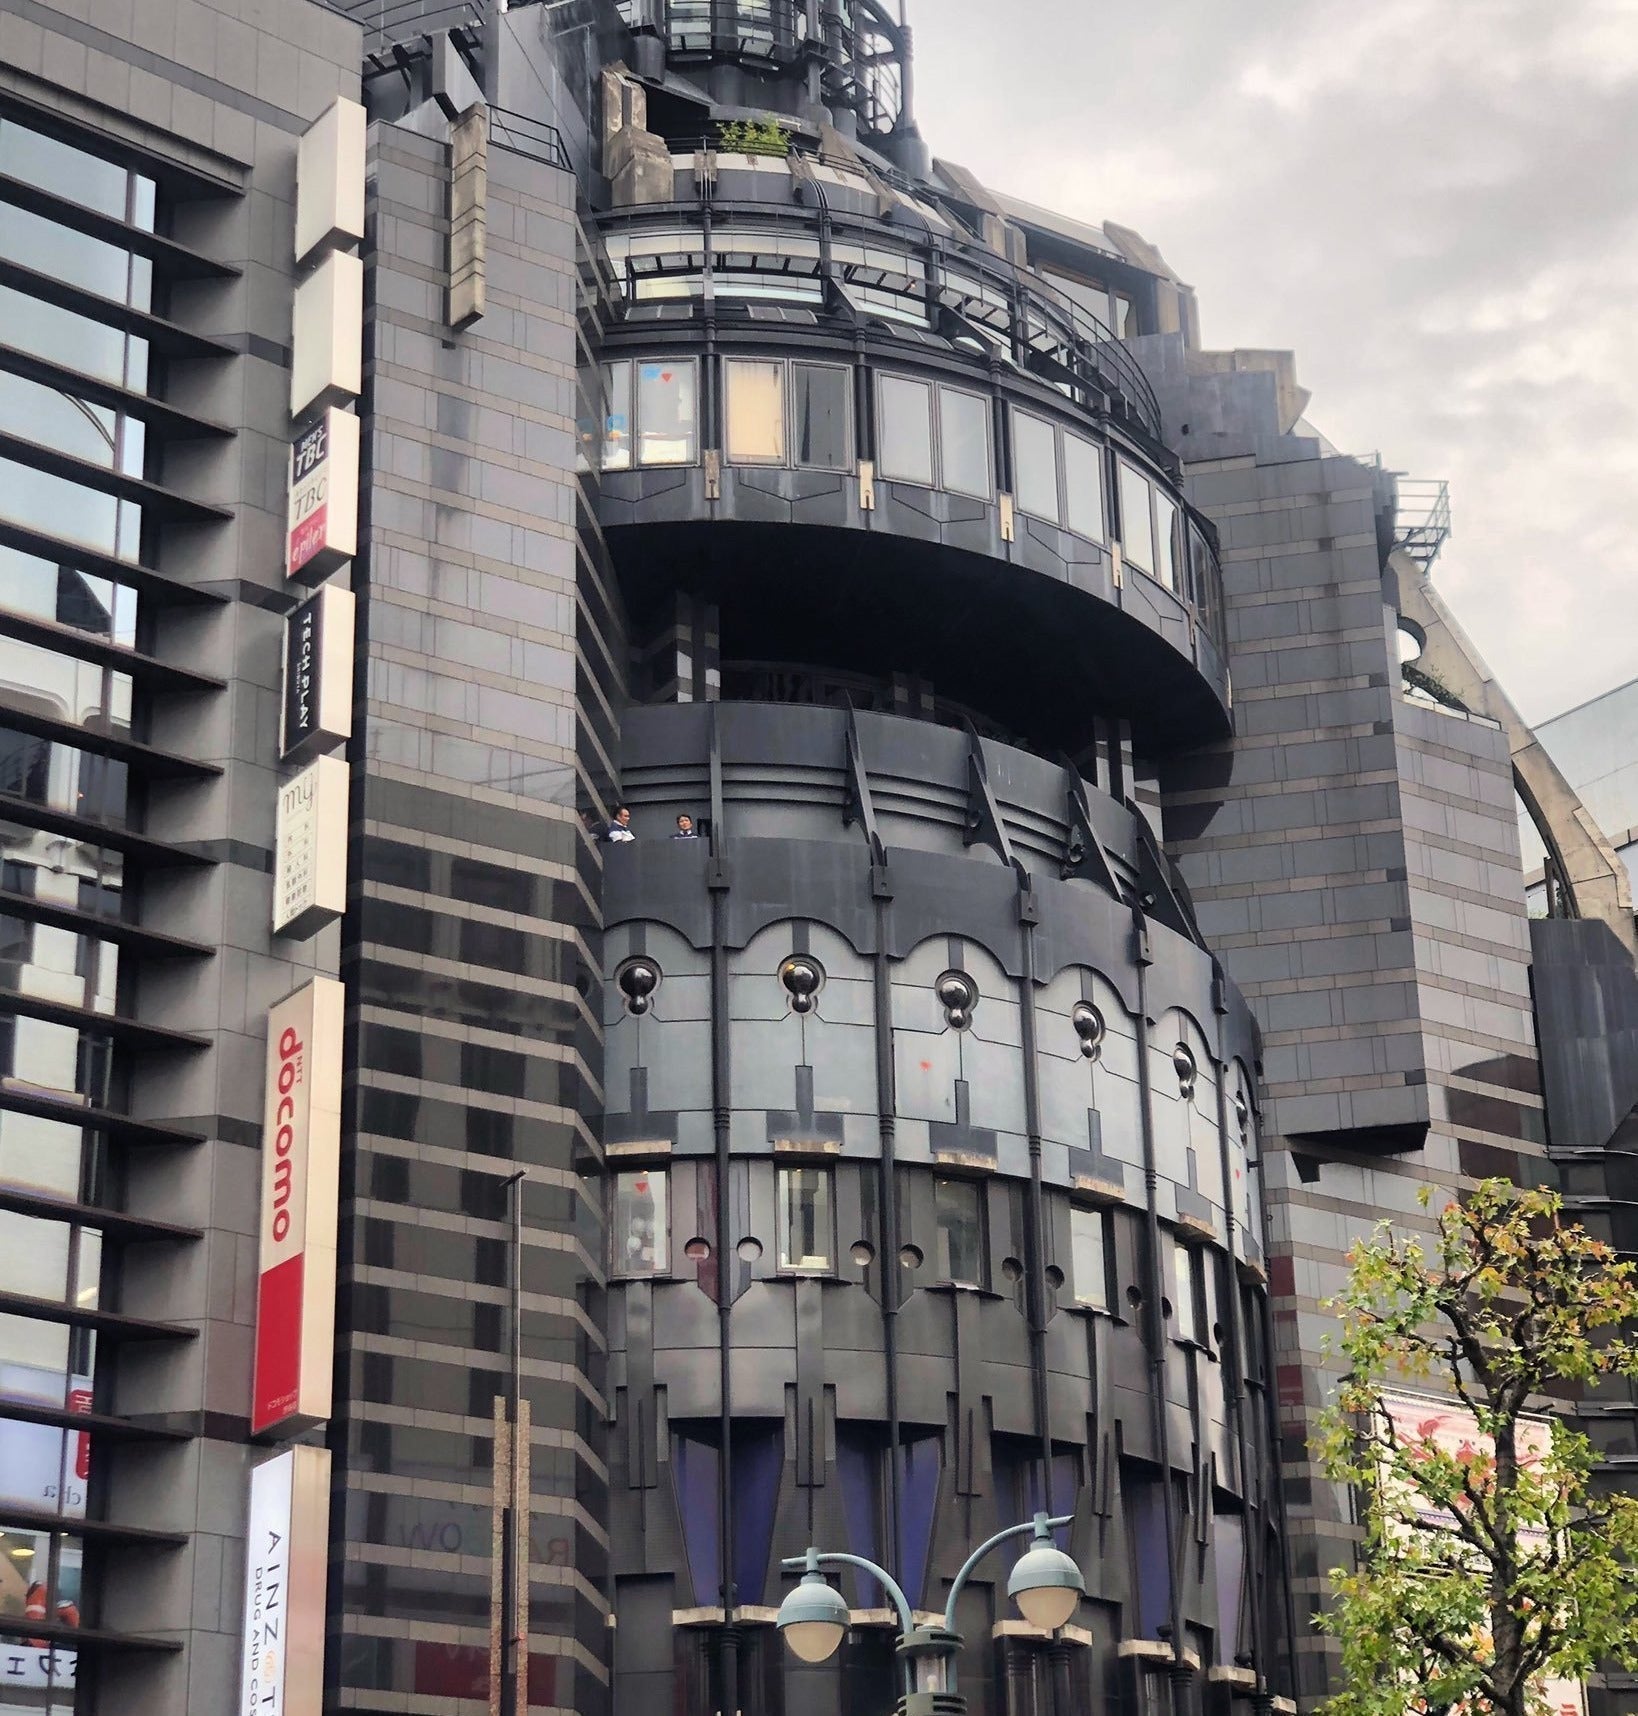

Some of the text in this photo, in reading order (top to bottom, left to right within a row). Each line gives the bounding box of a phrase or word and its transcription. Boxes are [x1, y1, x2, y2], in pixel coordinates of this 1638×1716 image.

[296, 433, 327, 477] TBC
[294, 477, 327, 520] TBC
[299, 612, 312, 728] TECH PLAY
[283, 772, 314, 814] my
[273, 1027, 304, 1242] docomo
[253, 1567, 263, 1620] DRUG
[264, 1531, 281, 1645] AINZ
[251, 1629, 260, 1671] AND
